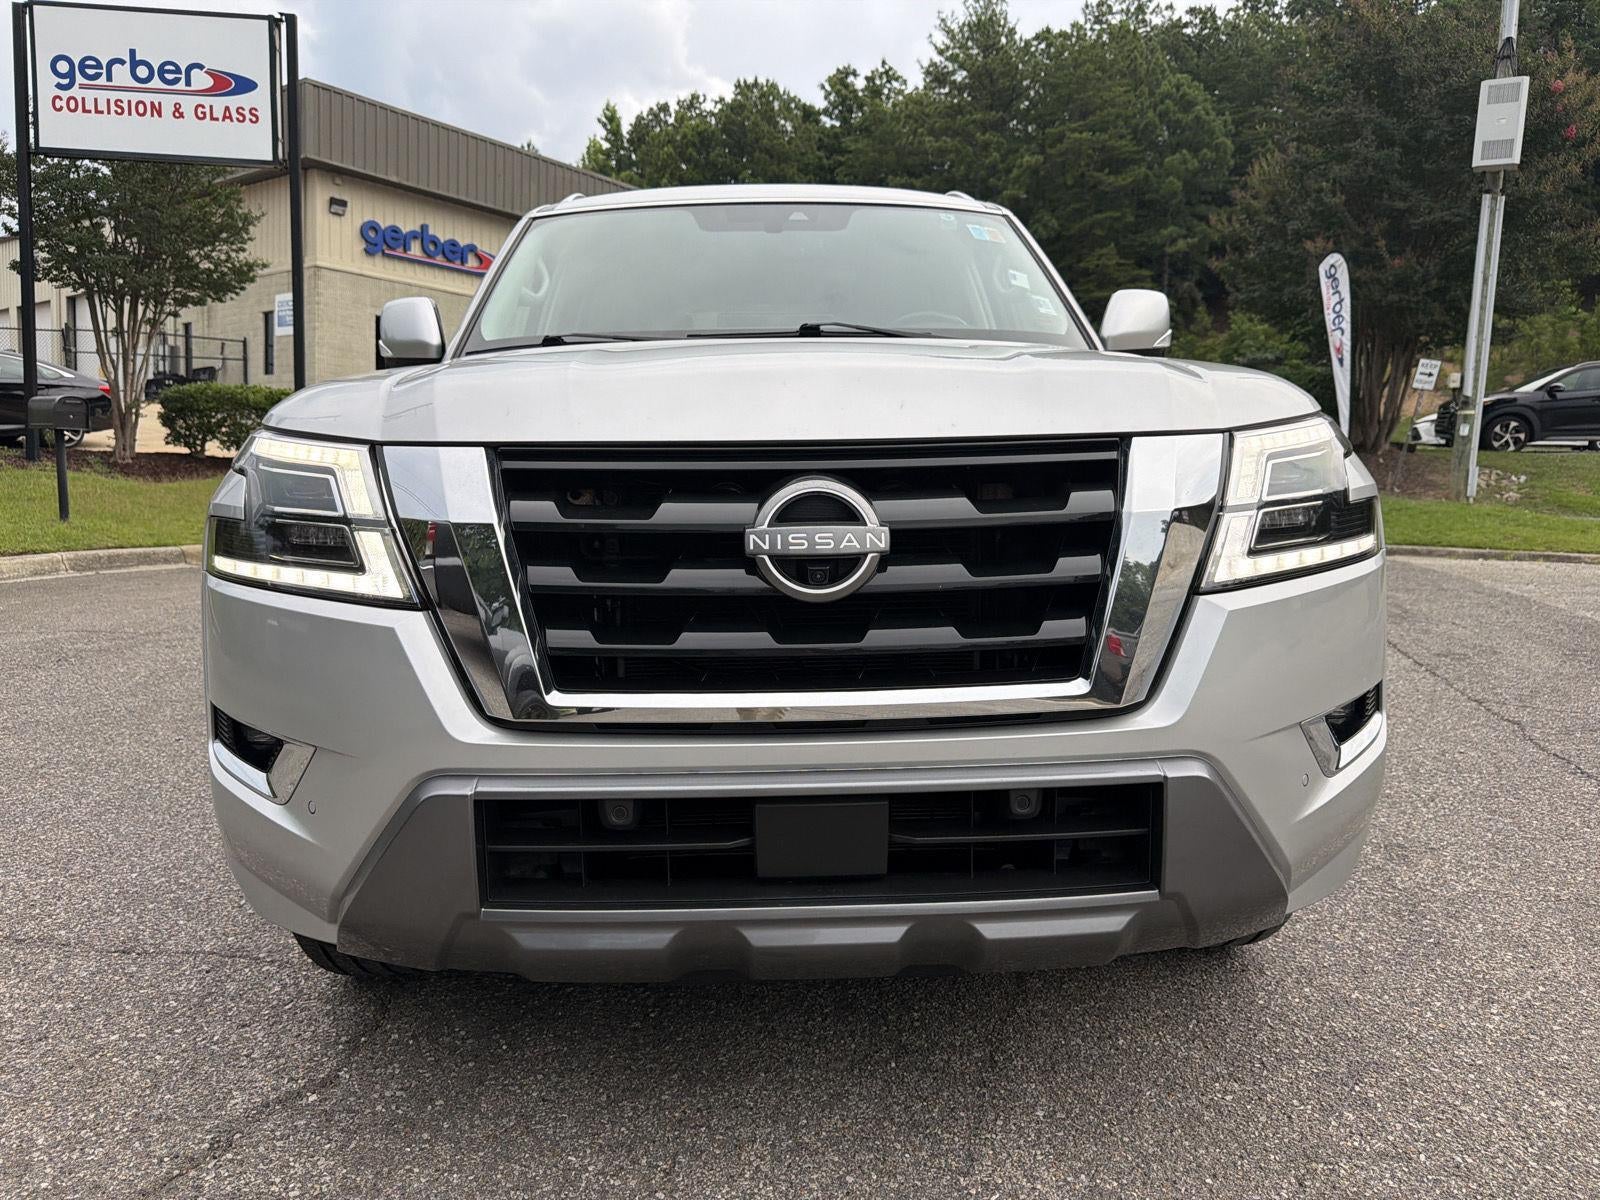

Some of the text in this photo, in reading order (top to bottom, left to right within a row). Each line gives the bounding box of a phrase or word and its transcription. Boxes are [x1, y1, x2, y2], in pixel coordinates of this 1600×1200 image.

[50, 48, 206, 91] gerber
[51, 95, 260, 124] COLLISION & GLASS
[360, 220, 478, 267] gerber
[1325, 264, 1344, 336] gerber
[750, 532, 885, 550] NISSAN
